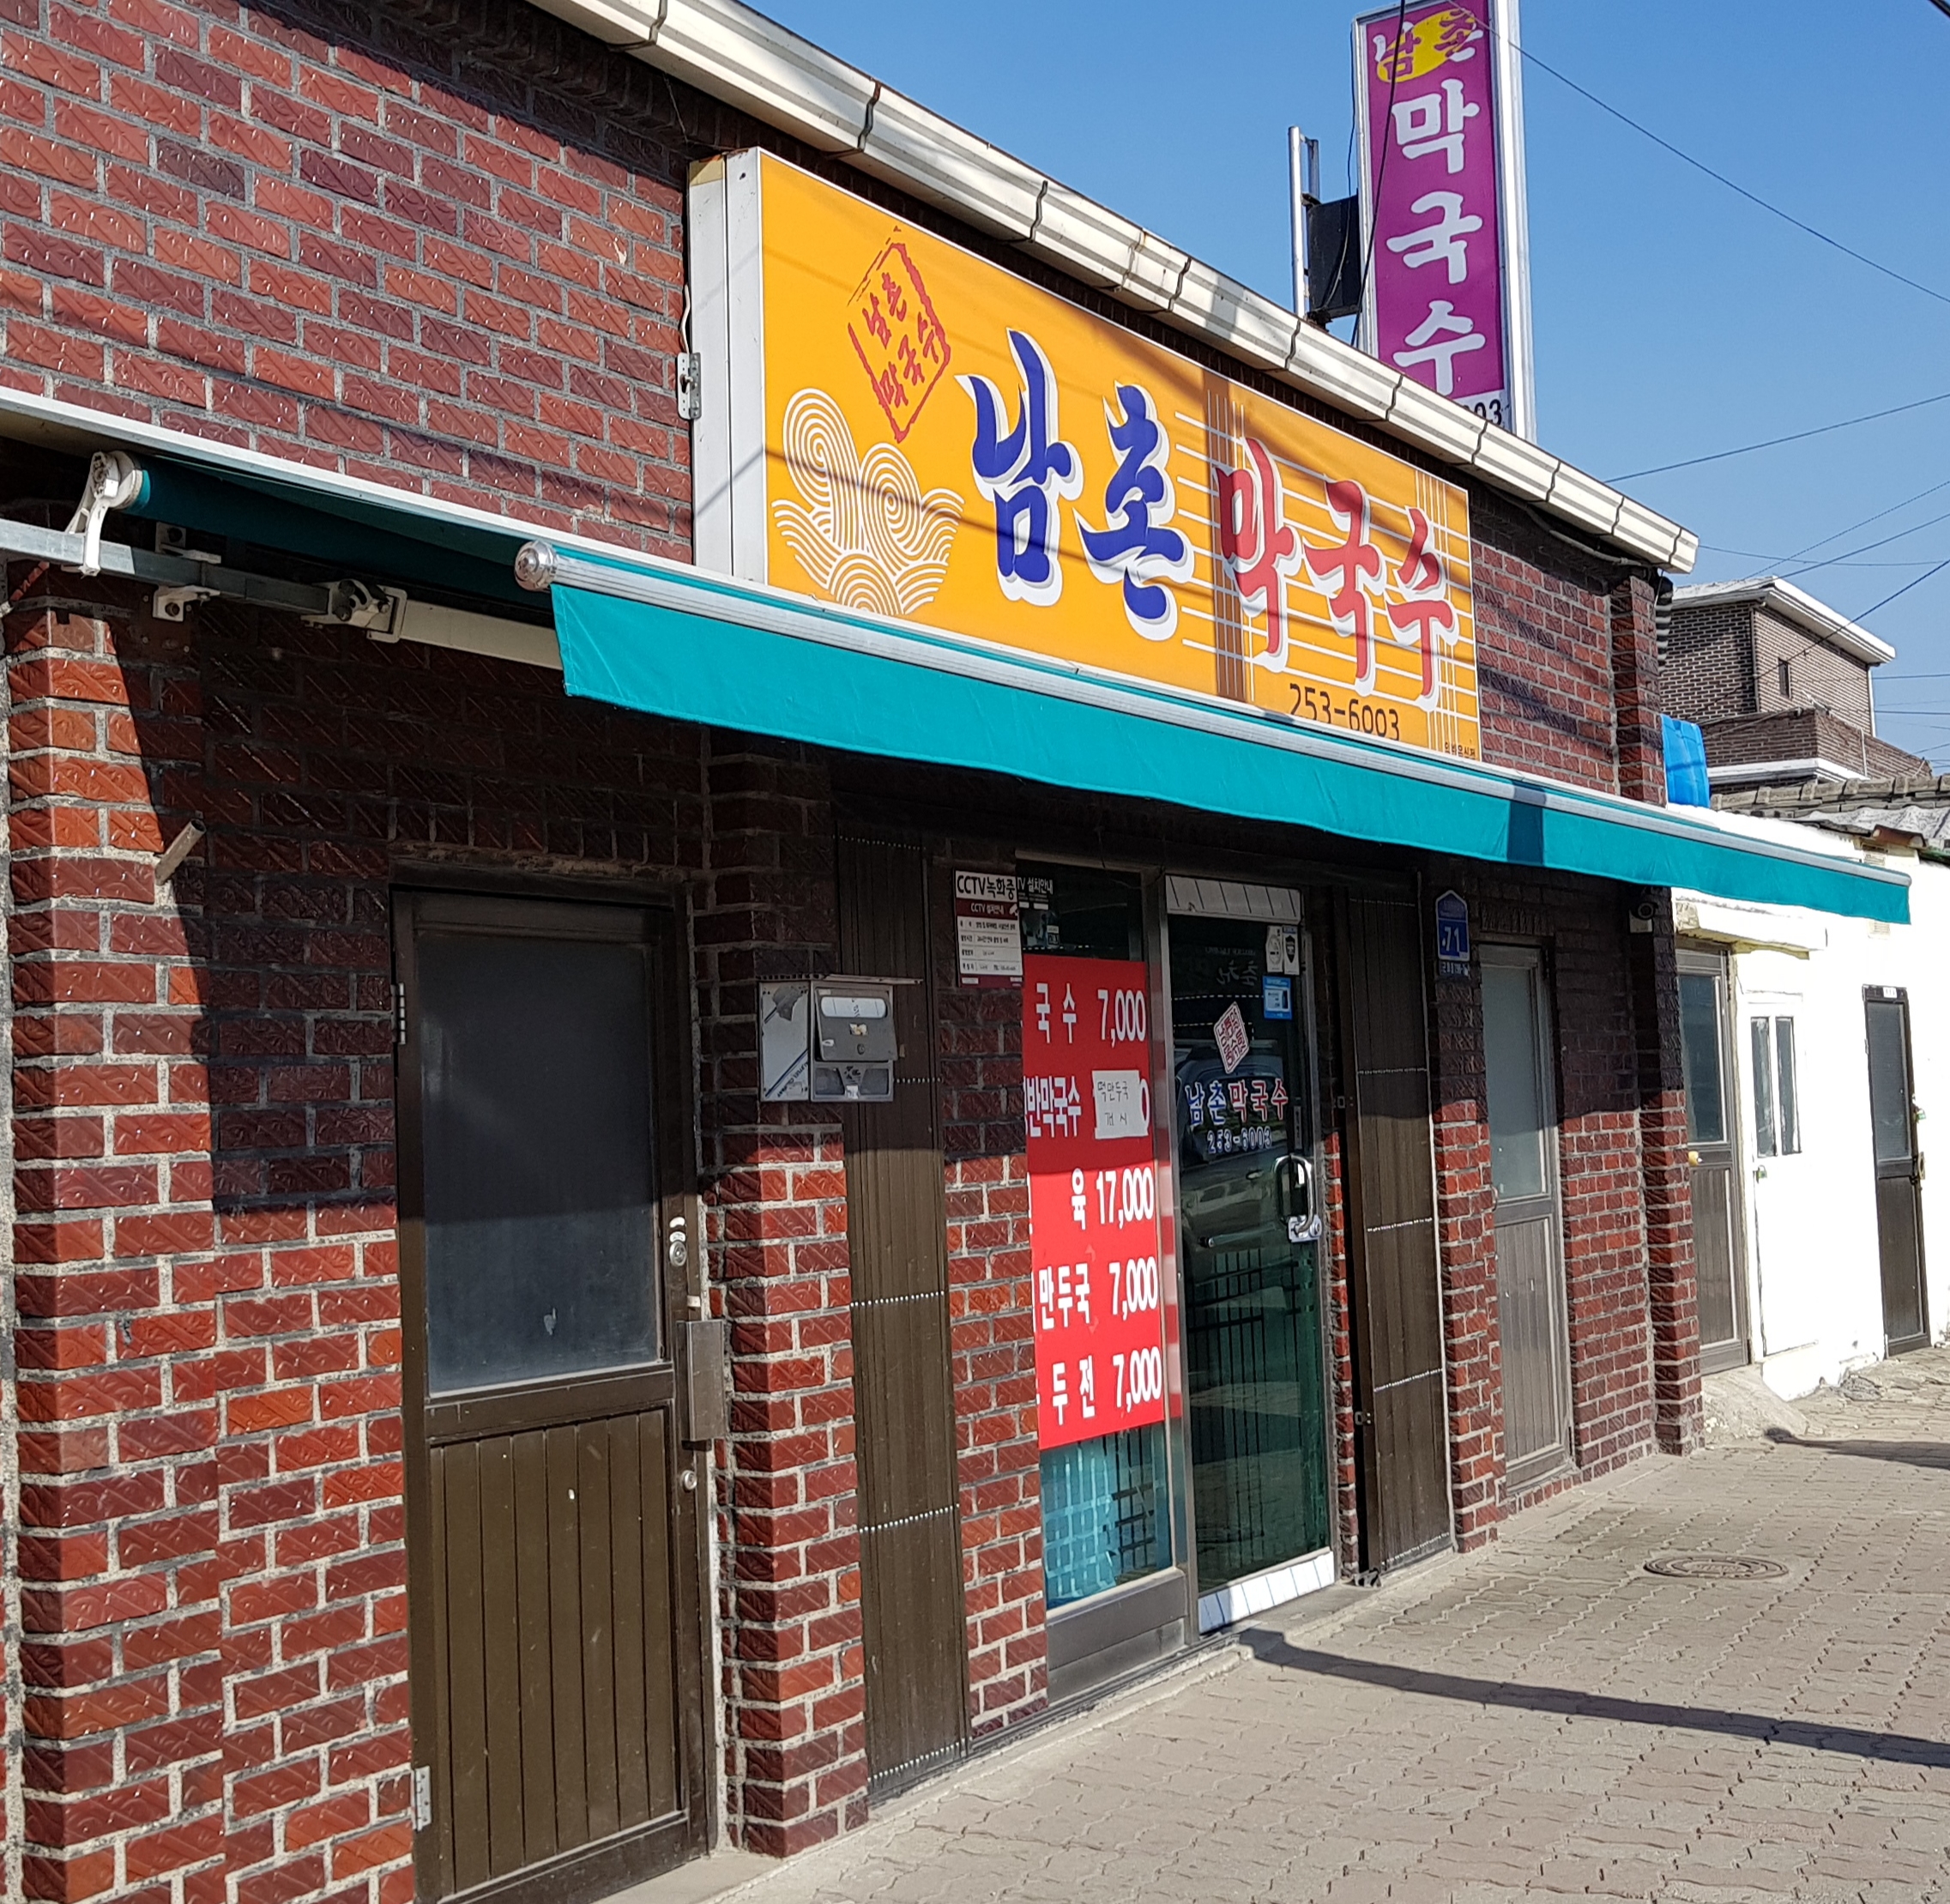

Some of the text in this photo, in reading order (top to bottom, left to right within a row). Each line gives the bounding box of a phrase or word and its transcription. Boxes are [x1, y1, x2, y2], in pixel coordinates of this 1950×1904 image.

[1386, 78, 1487, 395] 막국수
[955, 328, 1460, 711] 남촌 막국수
[1289, 683, 1401, 741] 253-6003
[1097, 989, 1146, 1048] 7,000
[1023, 1075, 1082, 1138] 반막국수
[1207, 1126, 1272, 1154] 253-6003
[1096, 1167, 1155, 1230] 17,000
[1032, 1256, 1158, 1330] 만두국 7,000
[1112, 1346, 1162, 1413] 7,000
